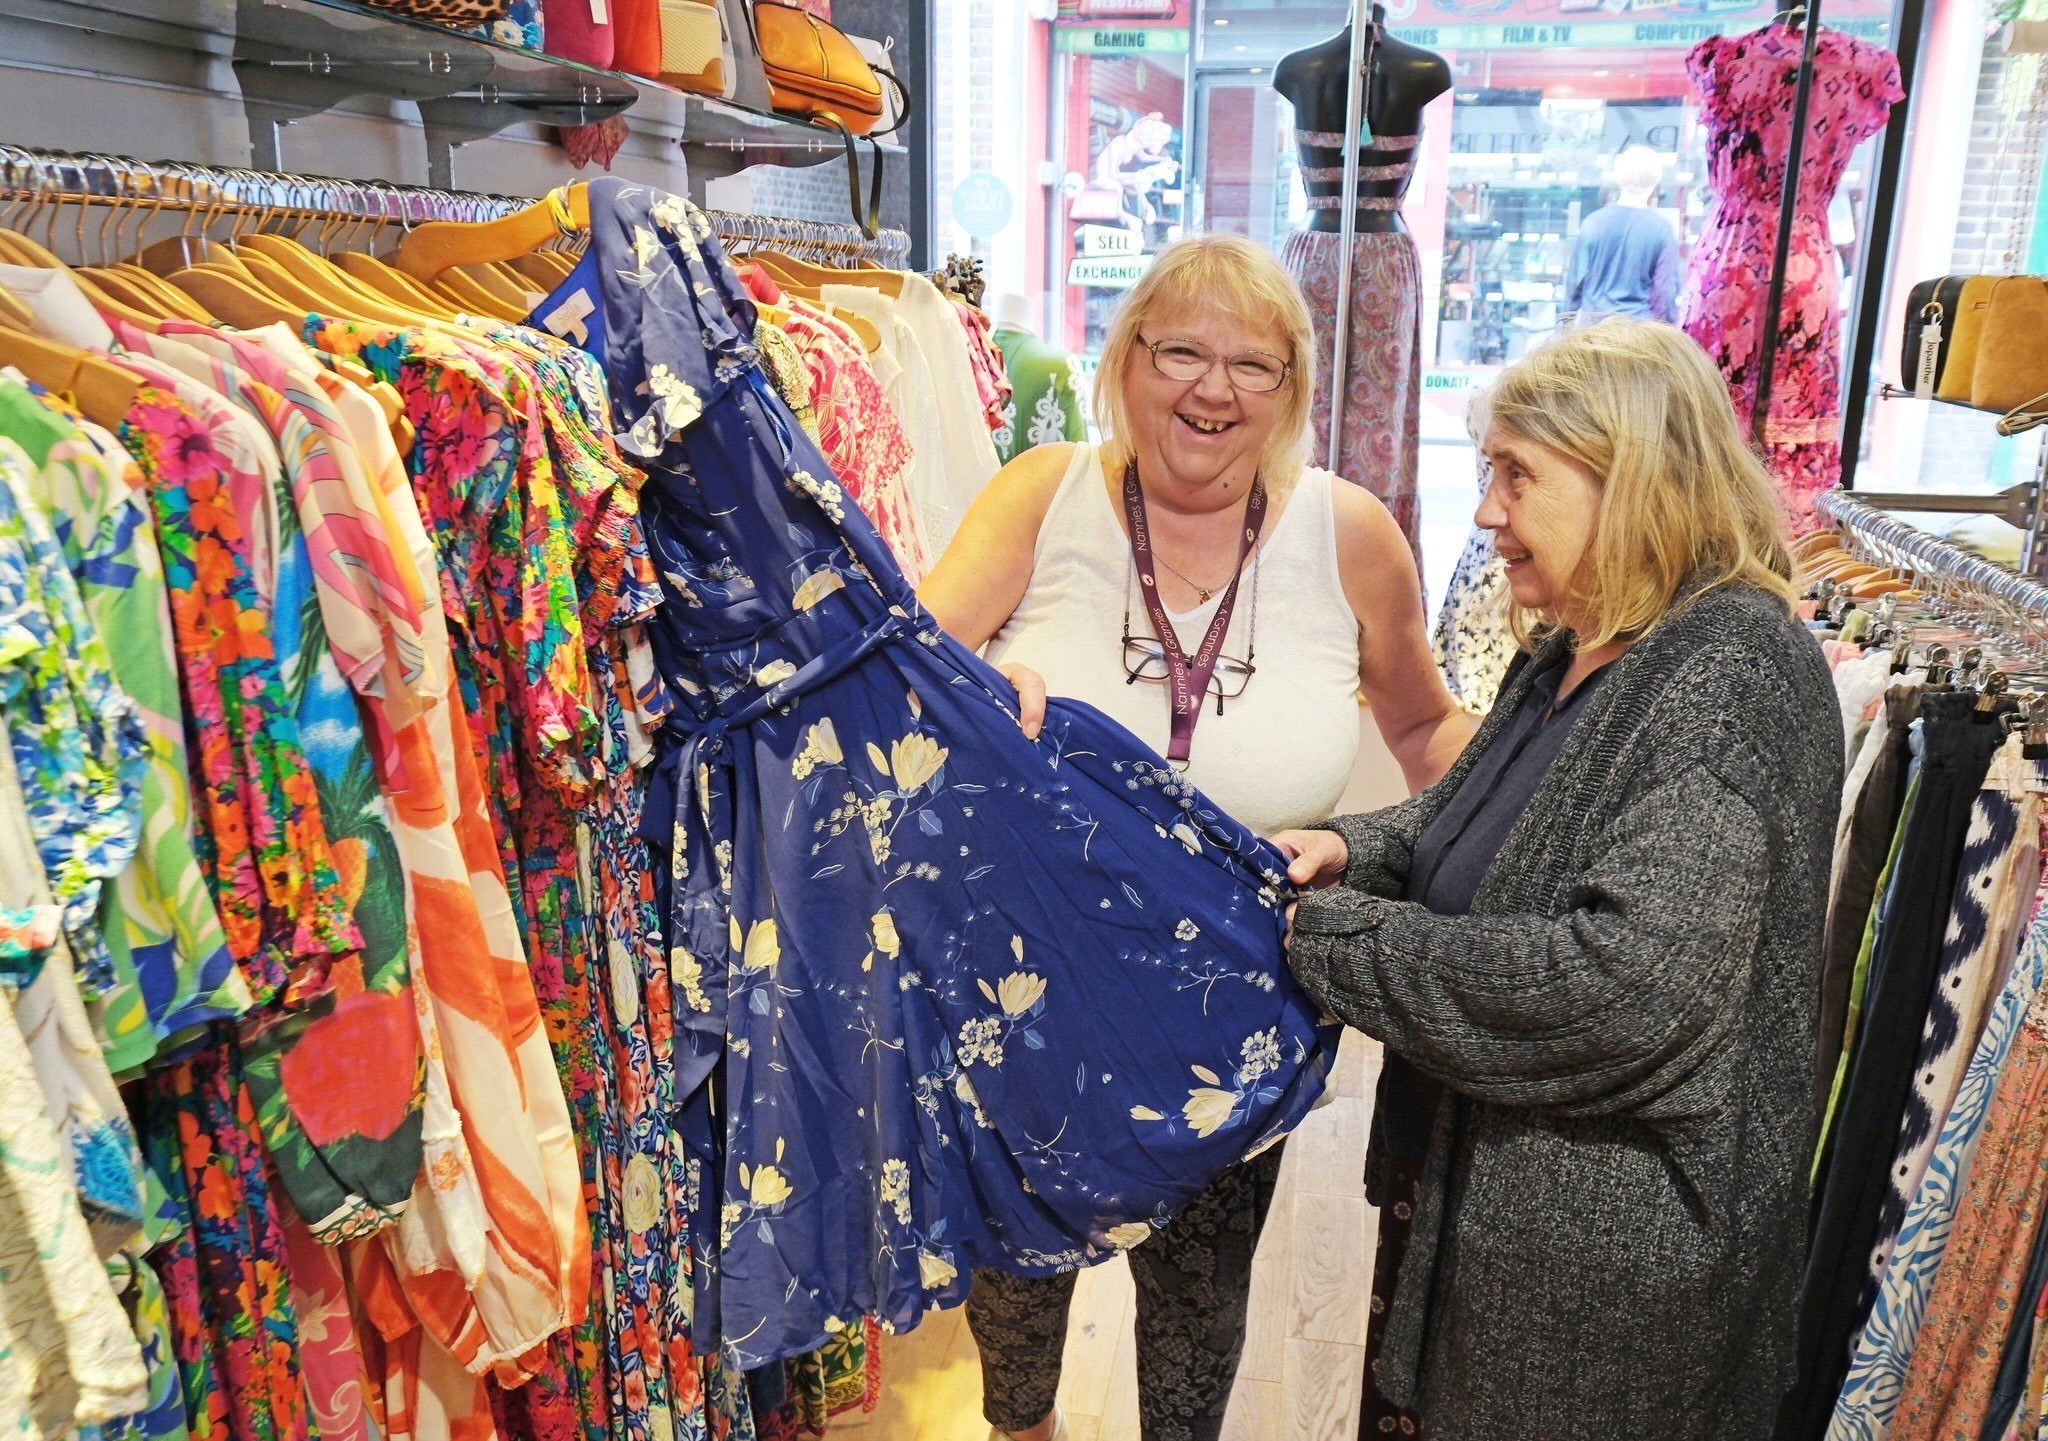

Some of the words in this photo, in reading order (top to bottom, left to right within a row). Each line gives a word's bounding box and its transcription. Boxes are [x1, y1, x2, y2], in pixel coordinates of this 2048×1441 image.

[1094, 32, 1145, 47] GAMING
[1503, 27, 1534, 43] FILM
[1538, 29, 1548, 41] &
[1552, 26, 1571, 42] TV
[1635, 22, 1724, 41] COMPUTING
[1098, 235, 1129, 250] SELL
[1924, 341, 1937, 384] Jopanther
[1131, 505, 1148, 551] Nannies
[1153, 607, 1177, 650] Grannies
[1197, 617, 1226, 668] Grannies
[1174, 662, 1188, 715] Nannies
